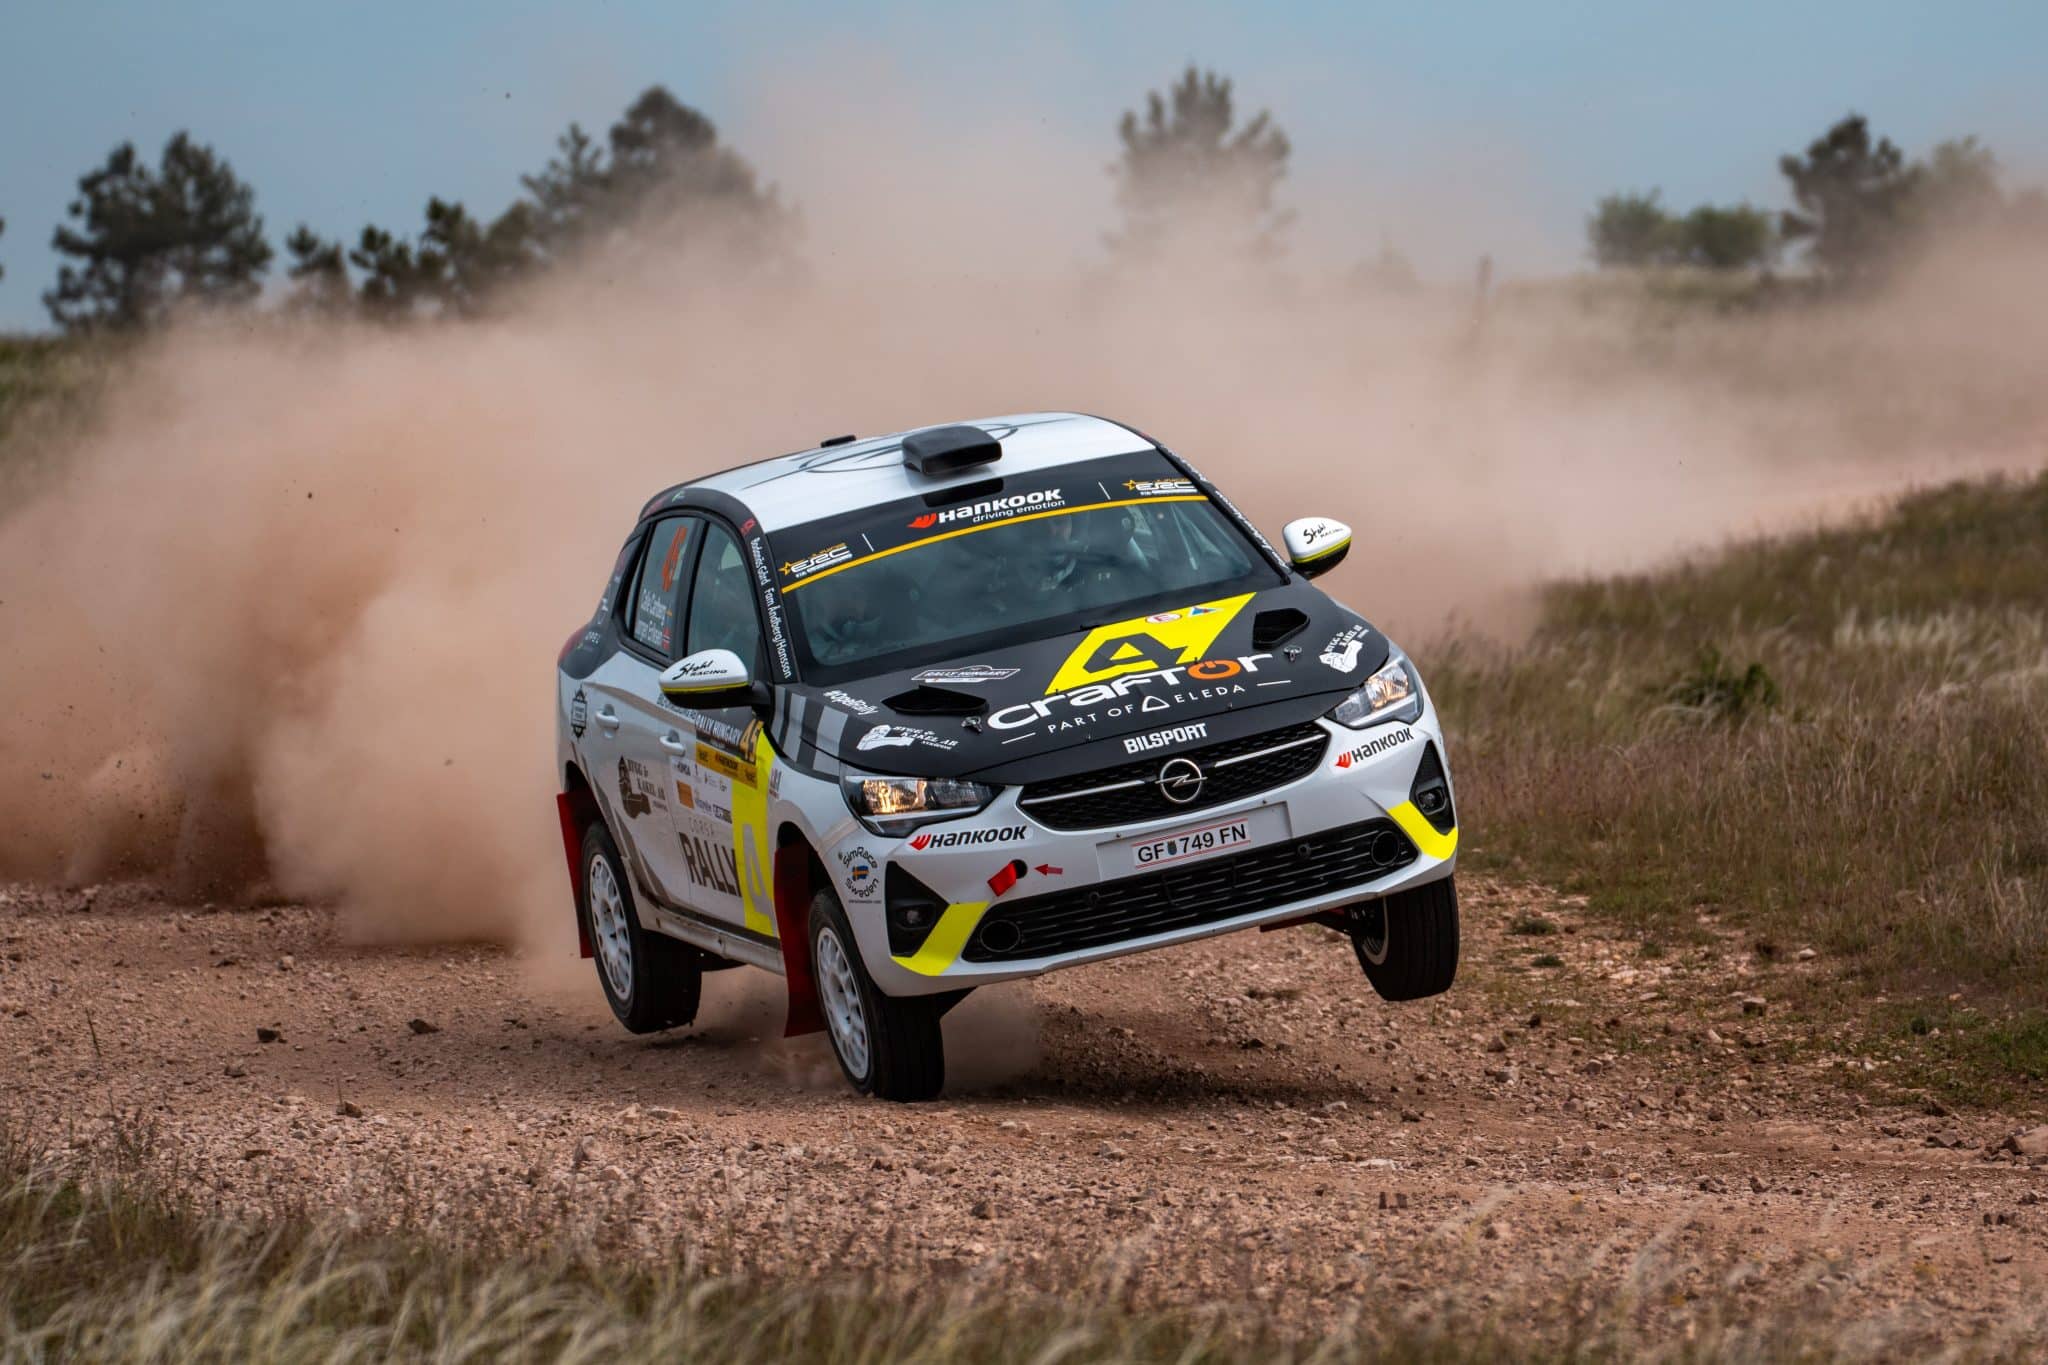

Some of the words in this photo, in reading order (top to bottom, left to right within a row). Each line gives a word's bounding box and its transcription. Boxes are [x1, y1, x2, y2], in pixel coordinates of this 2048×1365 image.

[973, 509, 1014, 523] driving
[1016, 500, 1066, 513] emotion
[764, 586, 775, 606] Fam
[1047, 713, 1097, 734] PART
[1107, 704, 1134, 717] OF
[1174, 684, 1246, 703] ELEDA
[1123, 723, 1208, 754] BILSPORT
[1138, 842, 1165, 862] GF
[1179, 831, 1214, 853] 749
[1220, 824, 1246, 844] FN
[679, 832, 742, 898] RALLY
